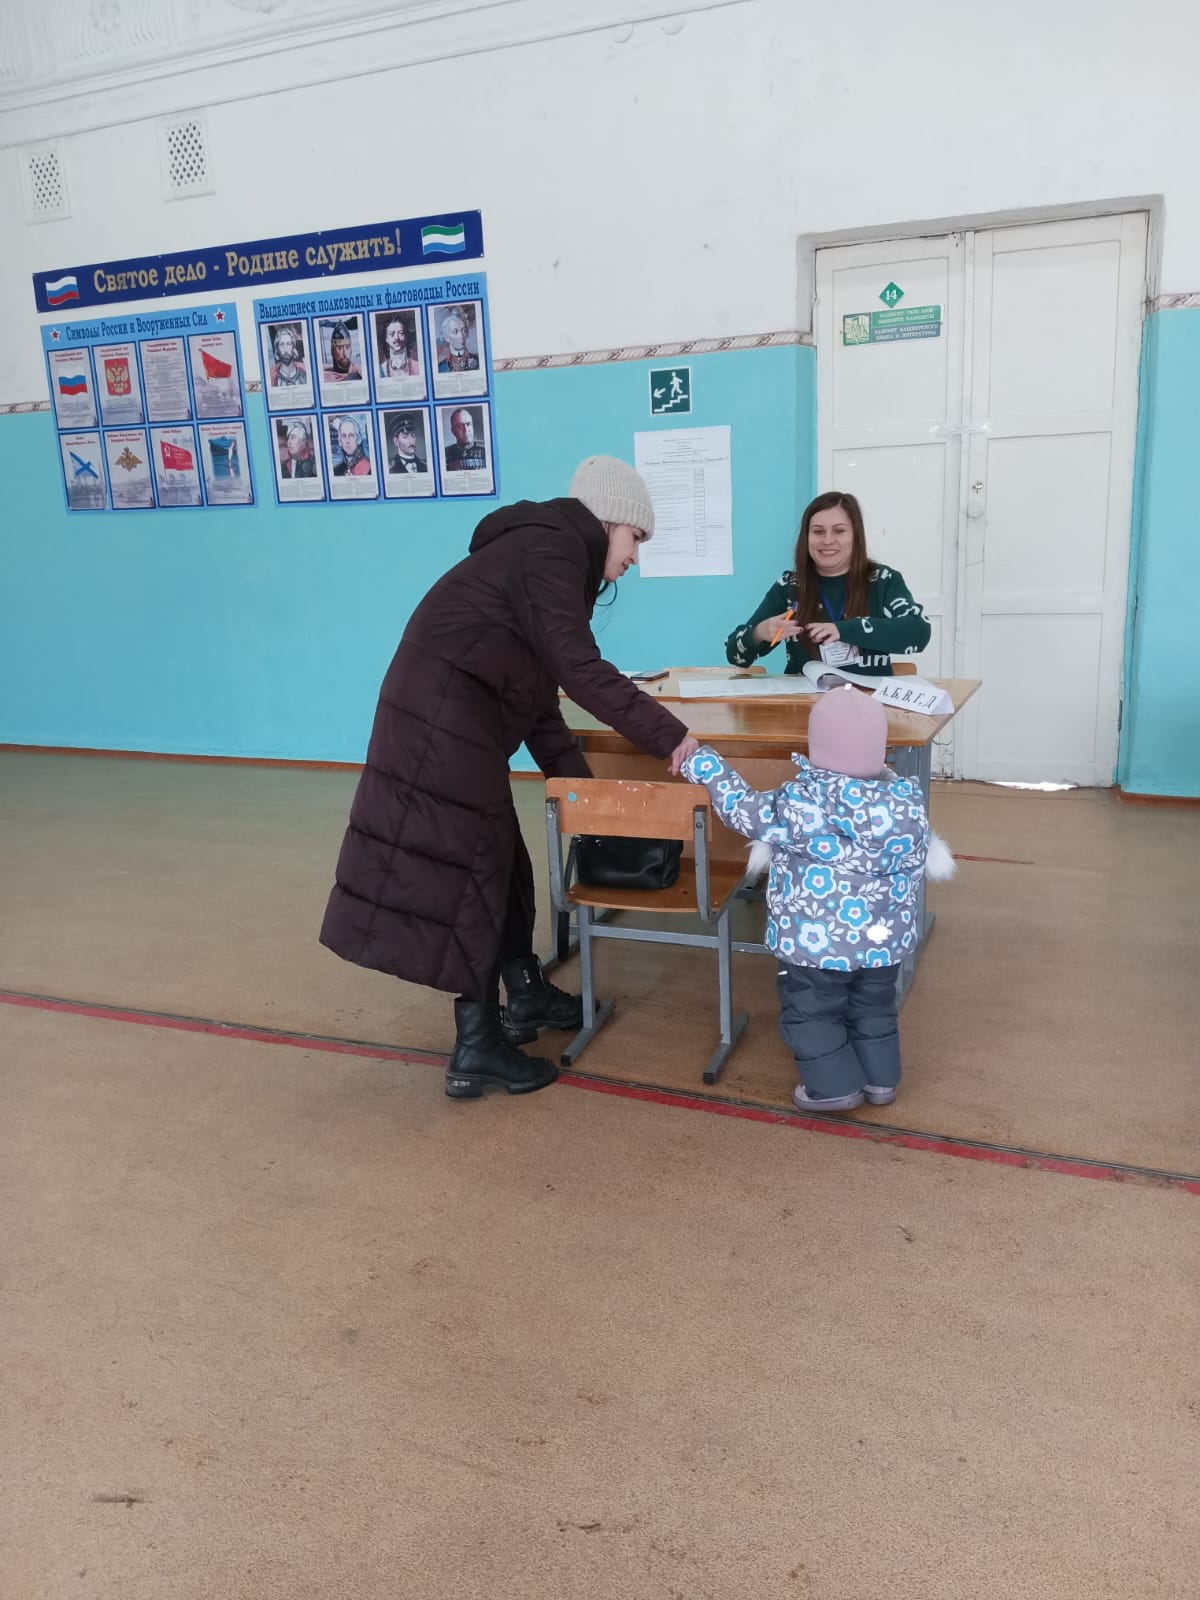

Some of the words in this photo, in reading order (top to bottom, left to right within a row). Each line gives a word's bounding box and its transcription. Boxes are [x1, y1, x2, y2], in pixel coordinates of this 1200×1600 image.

[93, 269, 159, 293] Святое
[164, 261, 207, 286] дело
[225, 250, 299, 277] Родине
[305, 228, 402, 271] служить!
[259, 302, 317, 320] Выдающиеся
[318, 294, 375, 312] полководцы
[376, 295, 383, 306] и
[384, 285, 443, 308] флотоводцы
[445, 280, 480, 297] России
[885, 289, 898, 300] 14
[66, 325, 100, 342] Символы
[101, 321, 129, 337] России
[130, 324, 136, 333] и
[136, 315, 191, 336] Вооруженных
[192, 311, 208, 327] Сил
